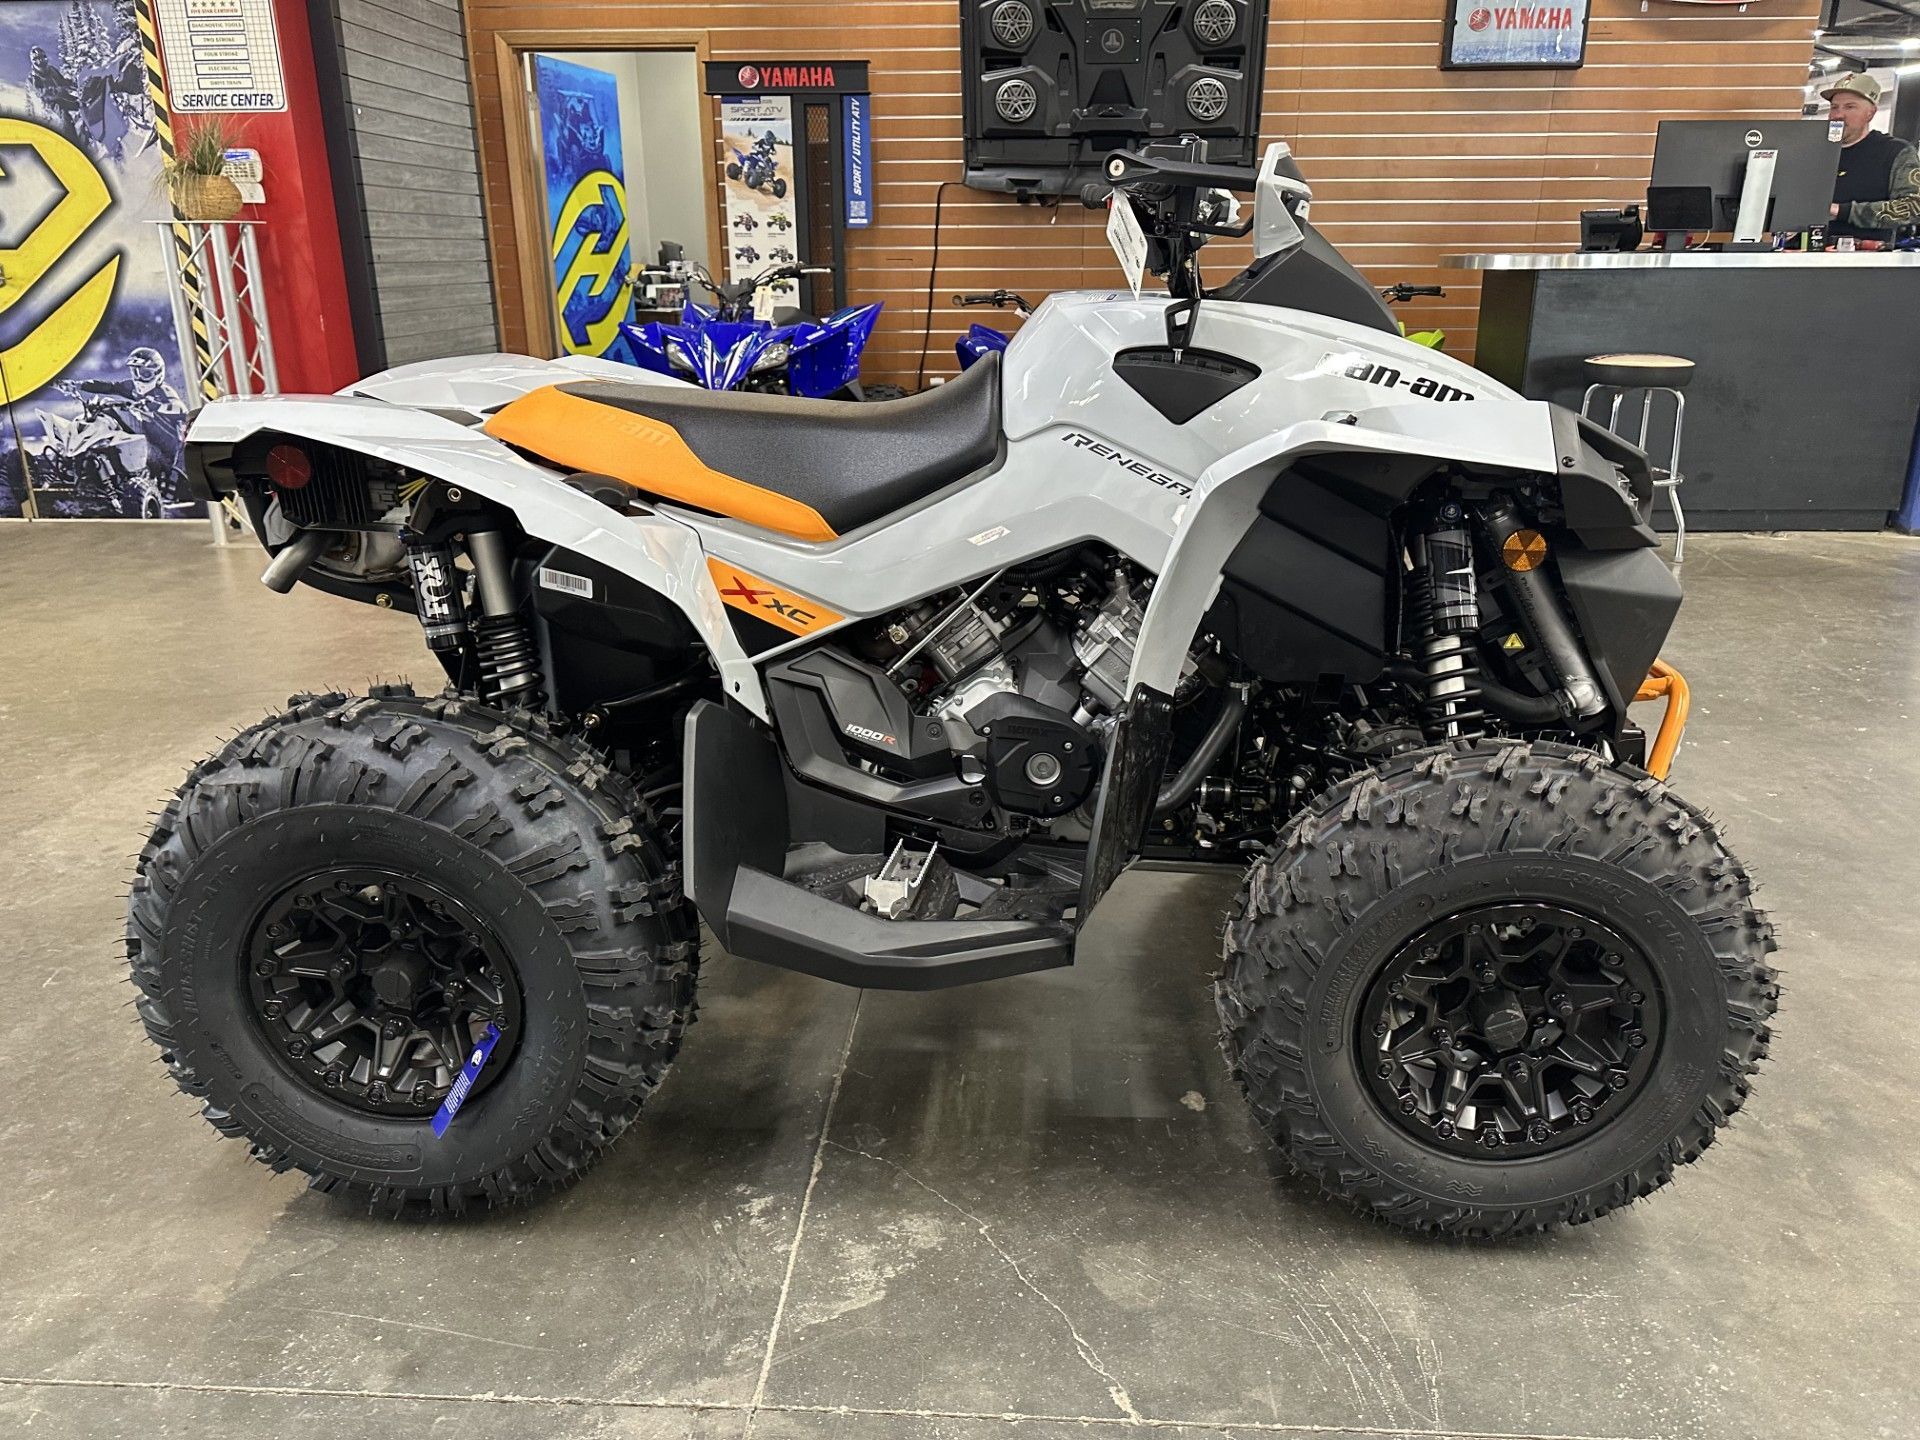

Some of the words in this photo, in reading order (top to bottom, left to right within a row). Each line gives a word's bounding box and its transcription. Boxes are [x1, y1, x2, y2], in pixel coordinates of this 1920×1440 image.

[1493, 7, 1573, 30] YAMAHA
[760, 66, 835, 87] YAMAHA
[182, 94, 228, 107] SERVICE
[231, 93, 274, 107] CENTER
[851, 97, 860, 119] ATV
[851, 117, 861, 156] UTILITY
[853, 162, 863, 196] SPORT
[1322, 352, 1475, 402] an-am
[1061, 432, 1193, 499] RENEGA
[414, 557, 453, 618] FOX
[846, 723, 897, 745] 1000R
